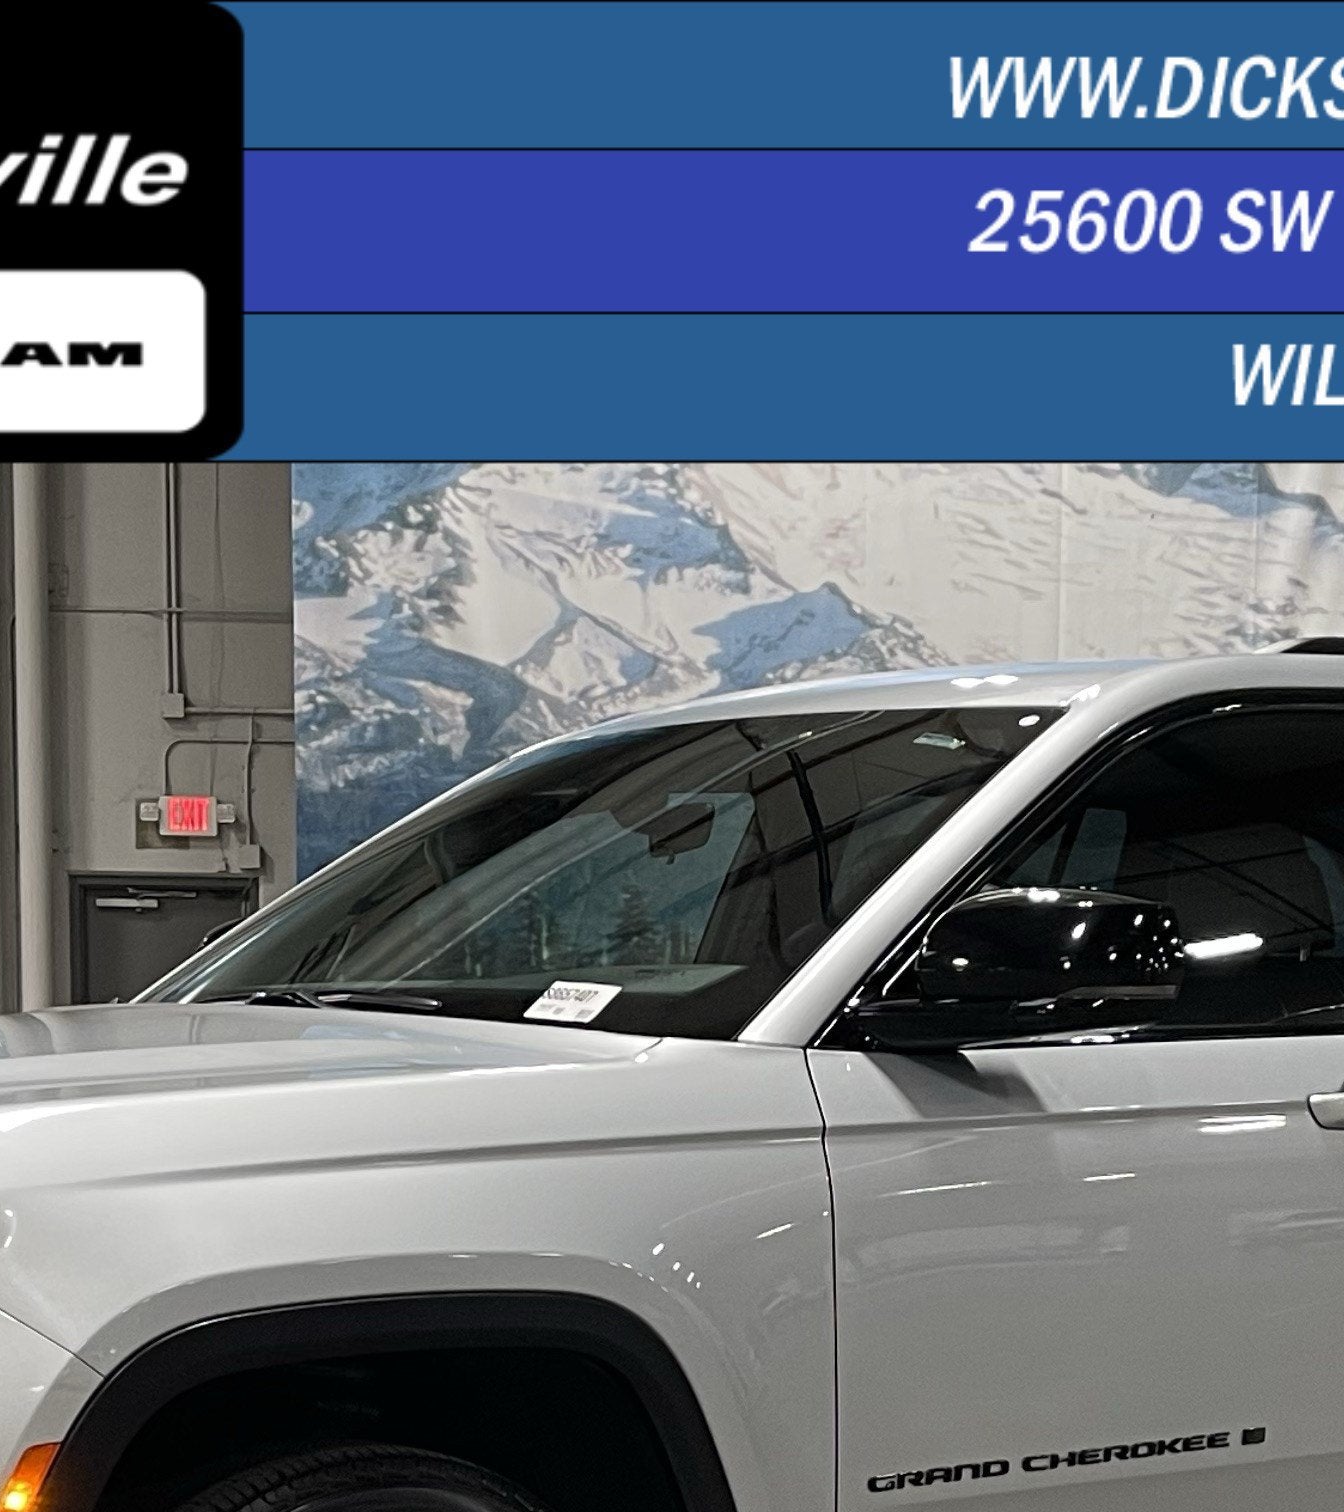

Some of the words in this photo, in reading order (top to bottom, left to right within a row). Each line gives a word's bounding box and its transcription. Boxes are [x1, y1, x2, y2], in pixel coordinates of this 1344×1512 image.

[168, 796, 210, 831] EXIT
[866, 1459, 1010, 1494] GRAND
[1020, 1430, 1231, 1474] CHEROKEE
